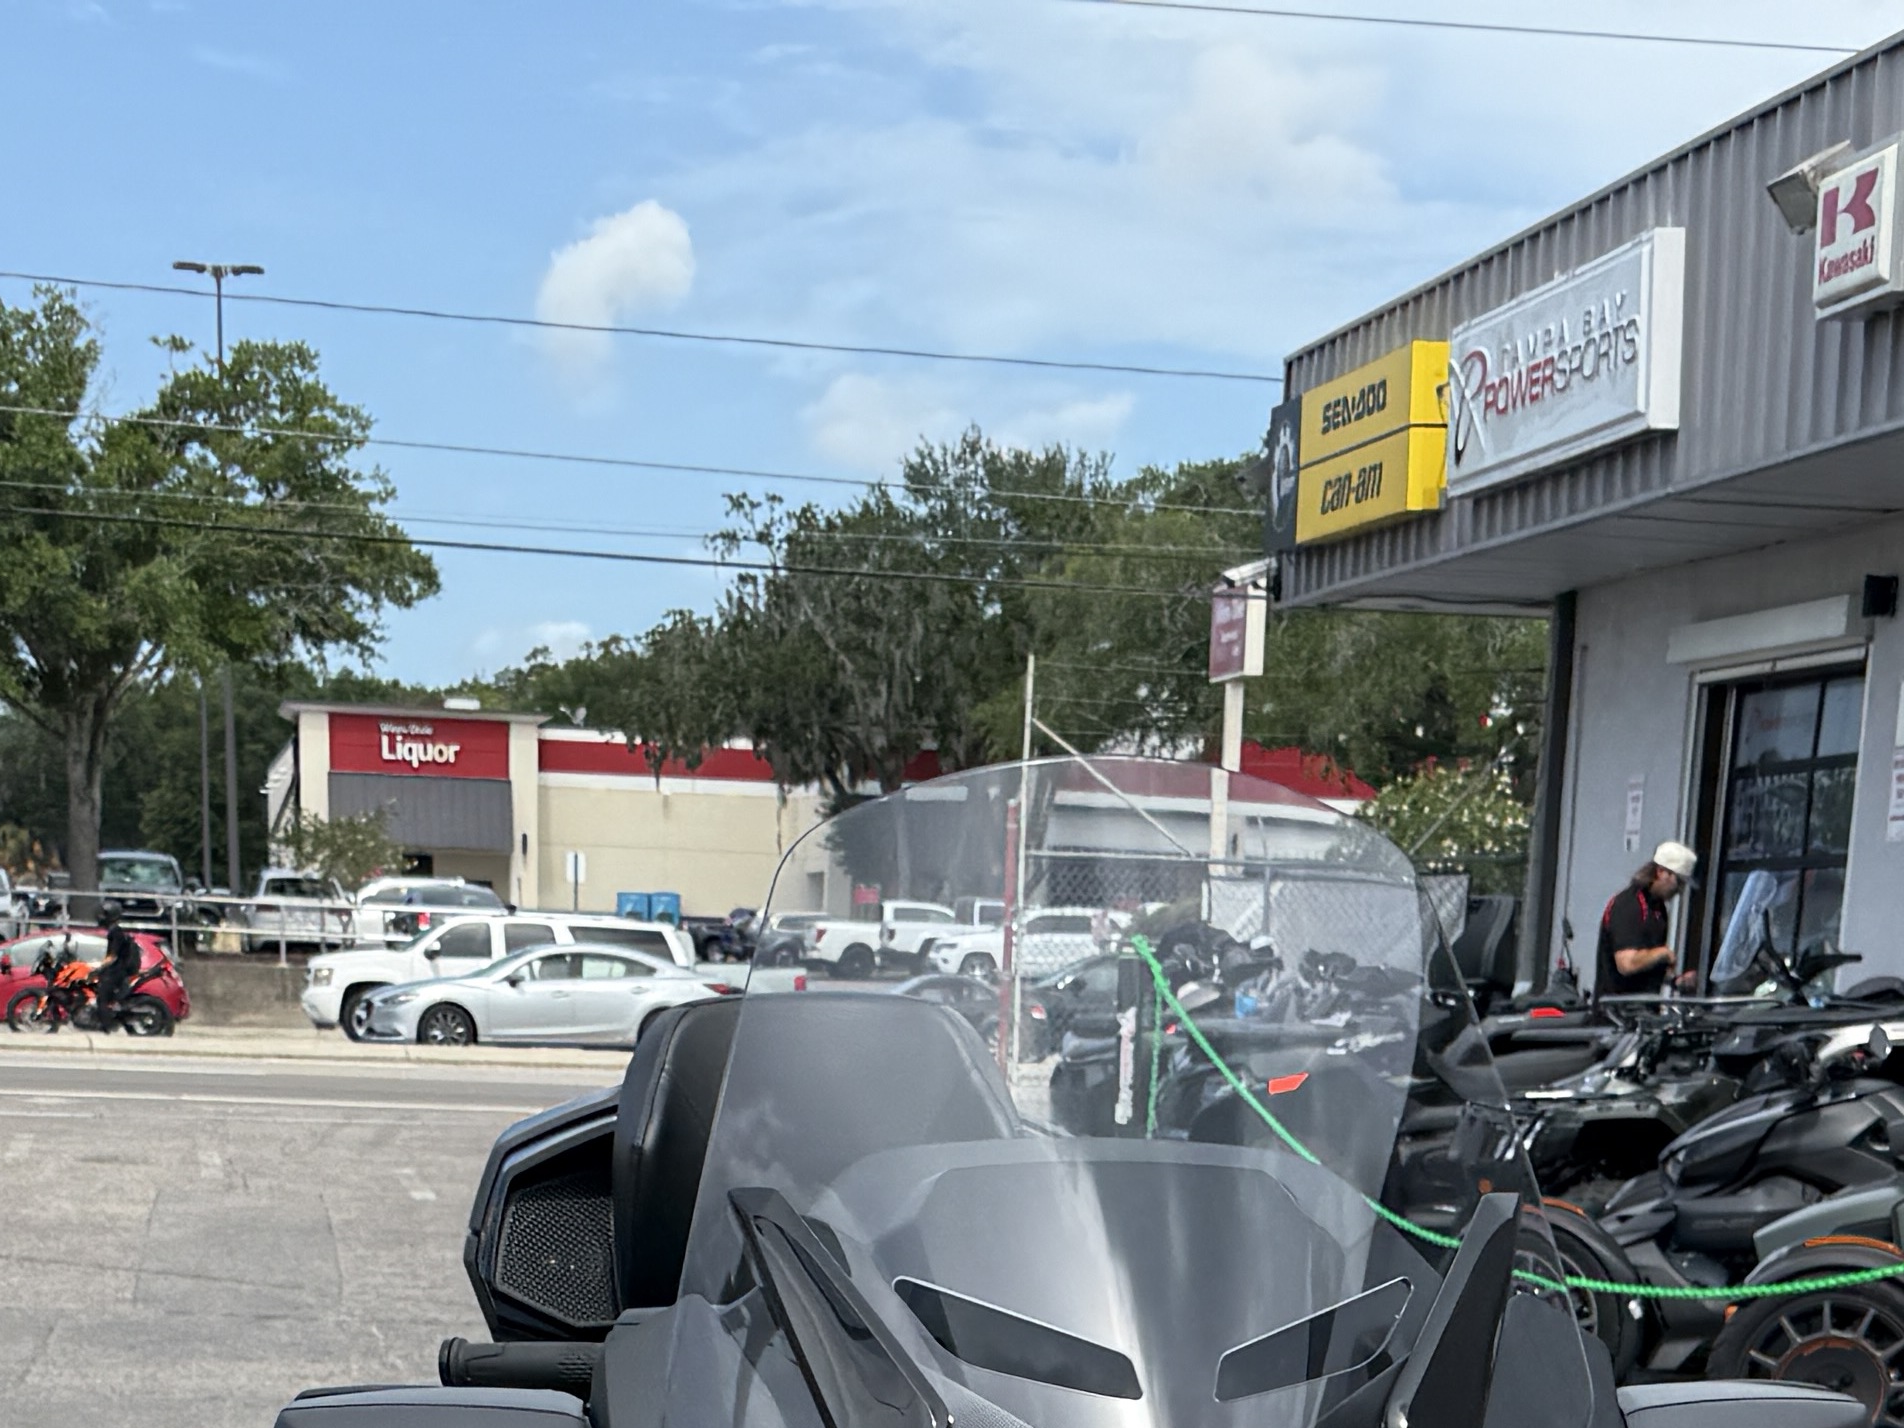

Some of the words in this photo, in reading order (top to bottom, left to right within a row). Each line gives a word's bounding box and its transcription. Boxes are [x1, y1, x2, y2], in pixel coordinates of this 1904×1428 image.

[1818, 235, 1875, 286] Kawasaki
[1483, 315, 1641, 421] POWERSPORTS
[381, 734, 460, 769] Liquor
